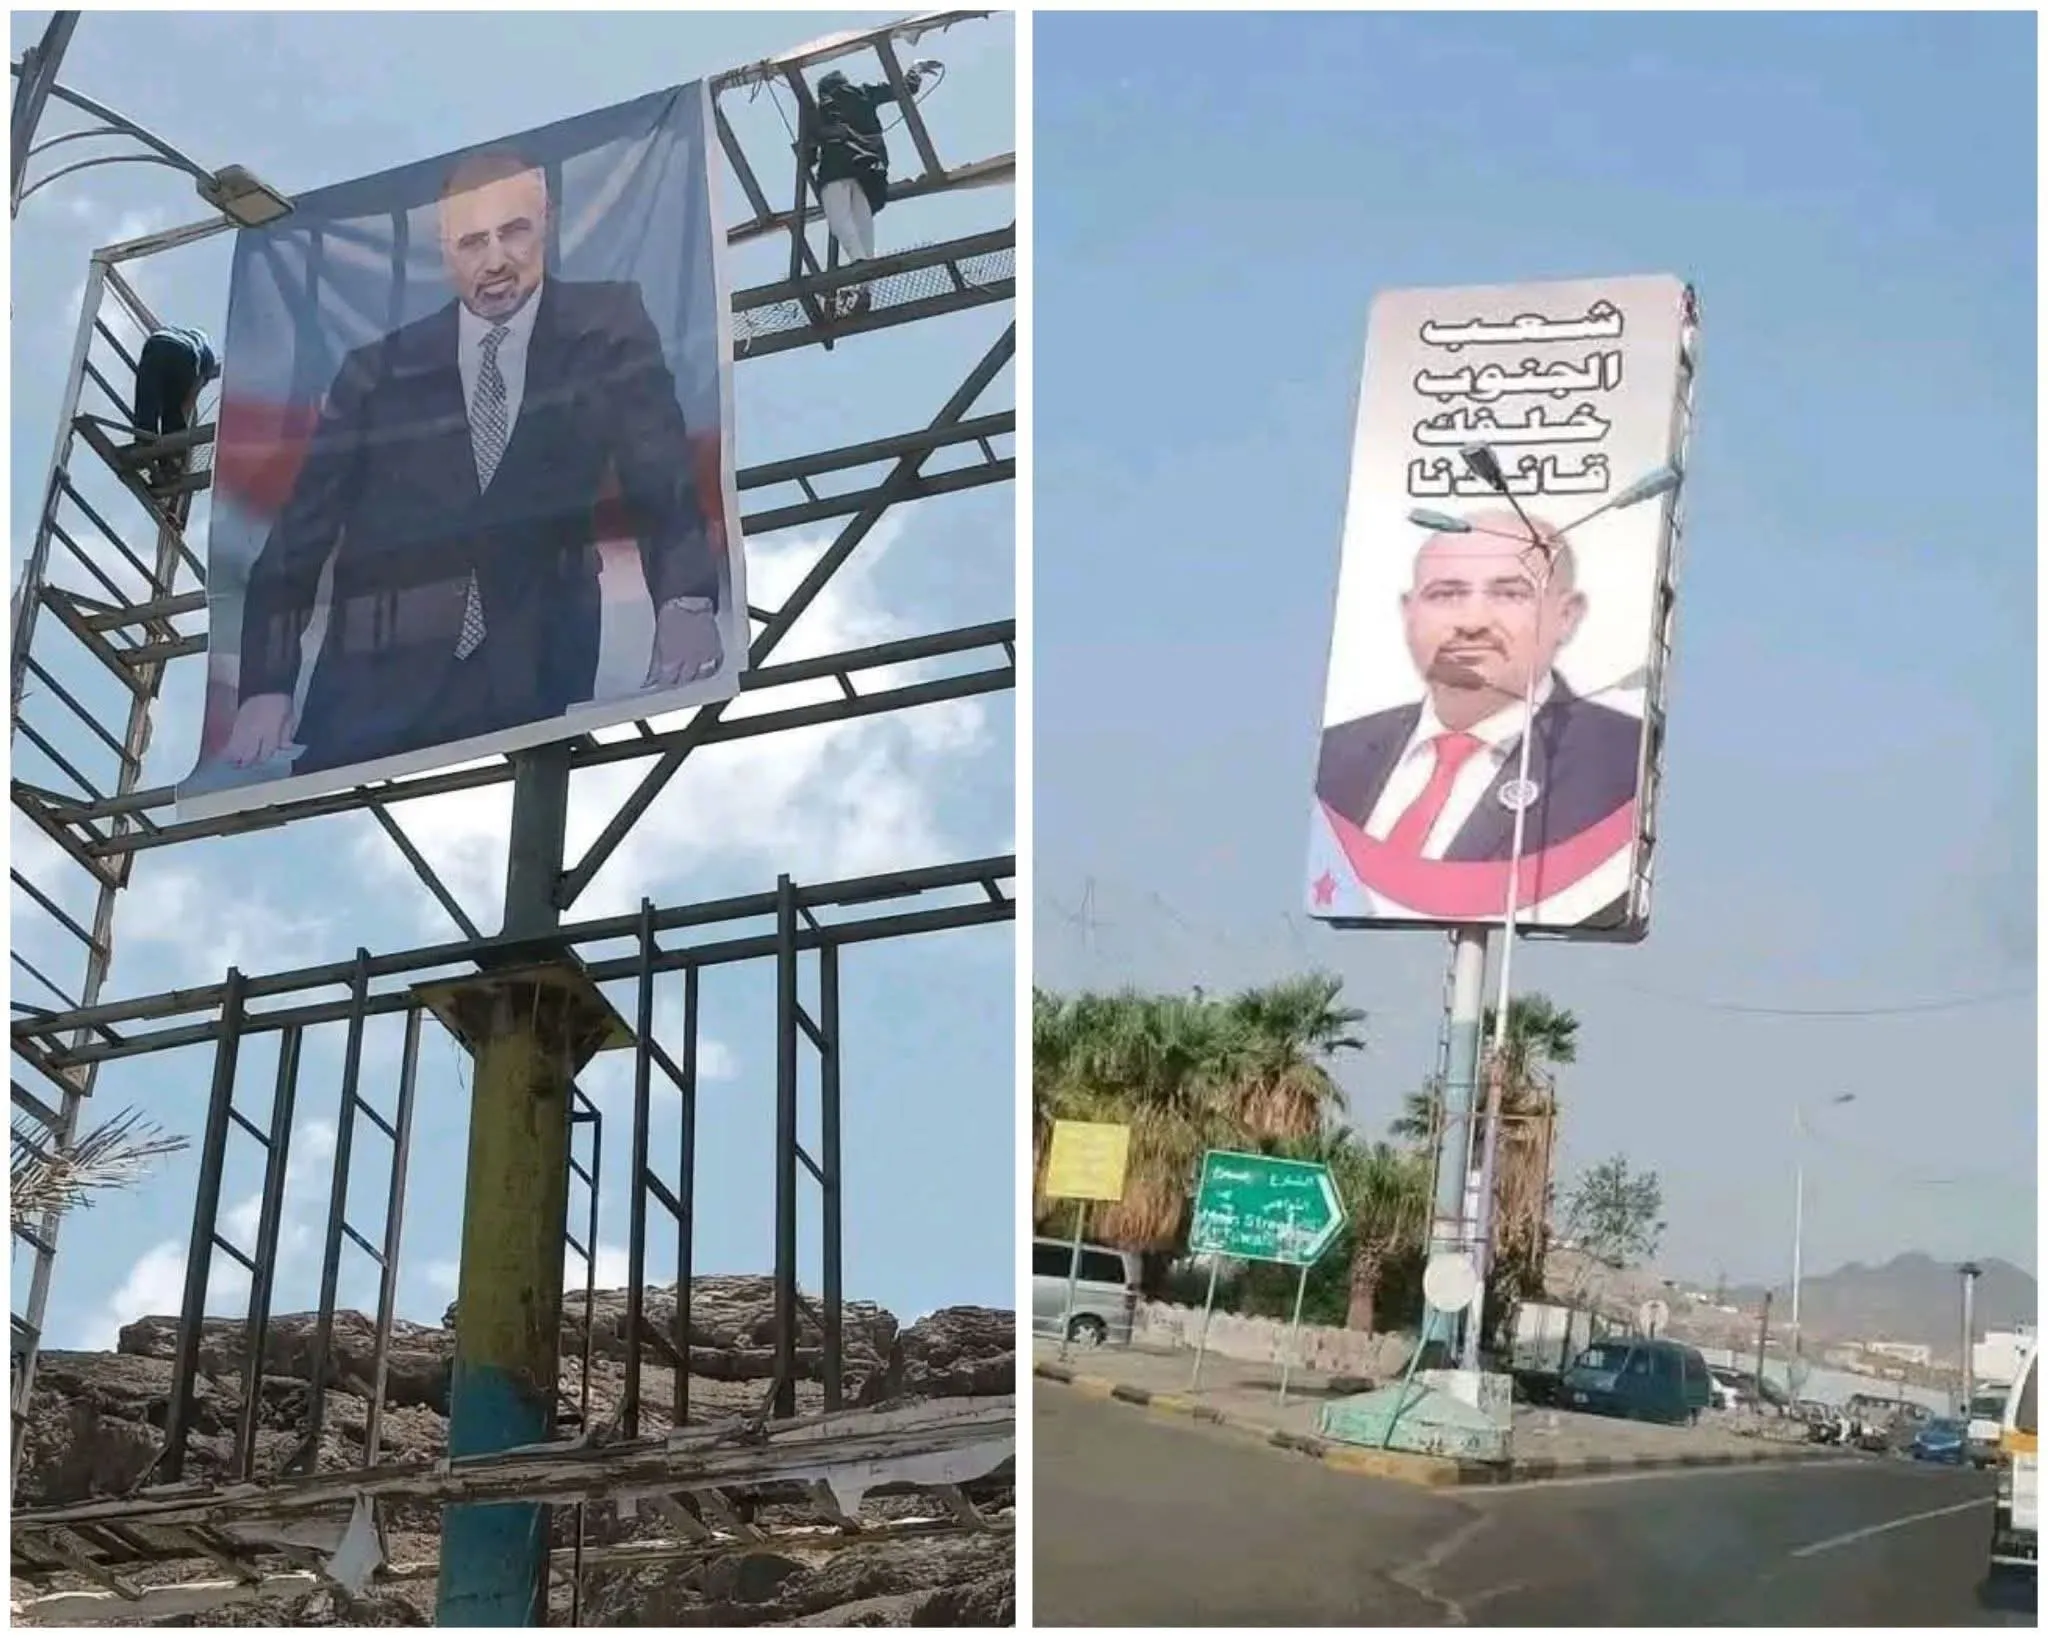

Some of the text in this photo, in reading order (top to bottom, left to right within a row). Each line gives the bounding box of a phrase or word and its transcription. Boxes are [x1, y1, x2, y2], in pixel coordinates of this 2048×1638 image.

[1420, 299, 1624, 352] شعب
[1414, 350, 1623, 404] الجنوب
[1412, 403, 1612, 446] خلفك
[1407, 453, 1610, 498] قائدنا
